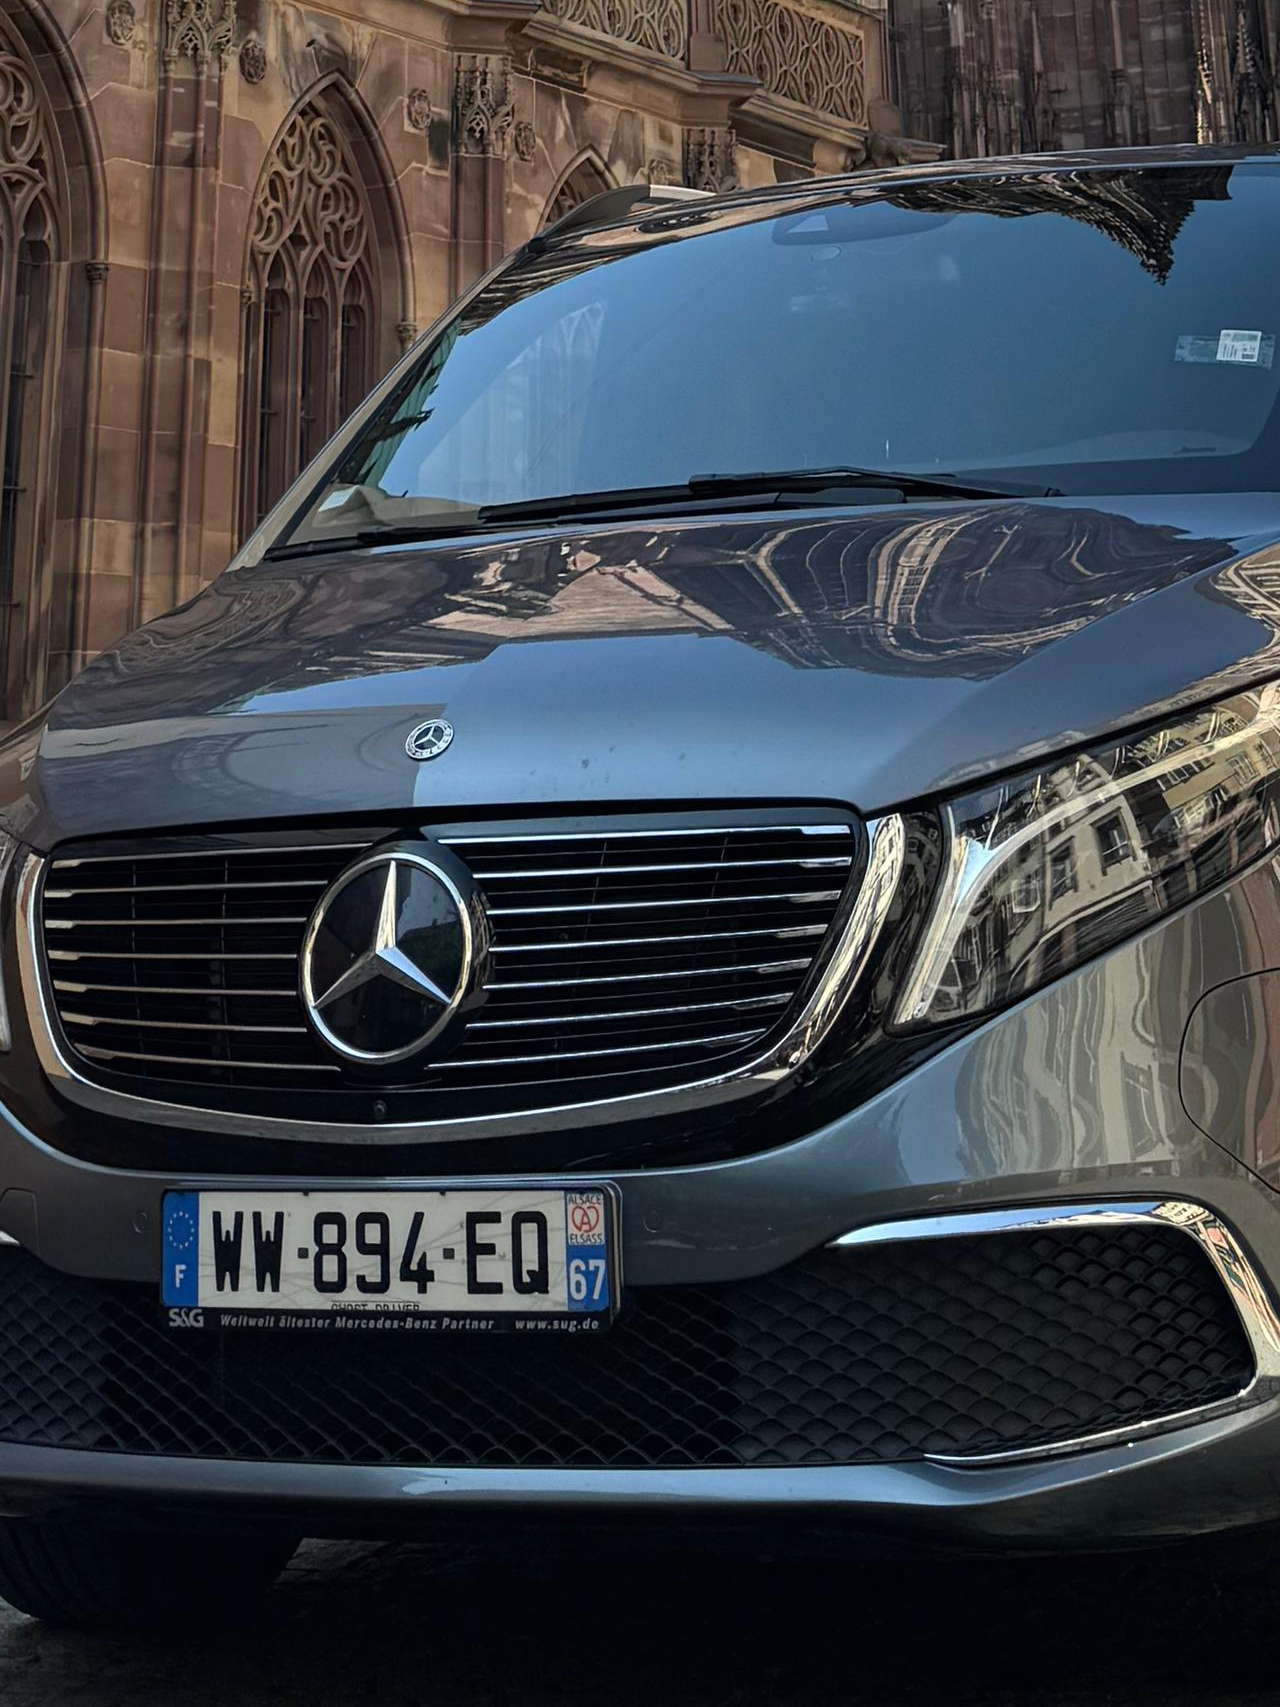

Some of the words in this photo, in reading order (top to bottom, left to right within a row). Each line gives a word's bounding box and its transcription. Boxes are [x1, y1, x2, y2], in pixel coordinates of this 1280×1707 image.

[568, 1194, 602, 1205] ALSACE
[569, 1233, 604, 1244] ELSASS
[175, 1264, 187, 1288] F
[570, 1259, 606, 1301] 67
[168, 1308, 204, 1328] S&G
[220, 1314, 275, 1329] Weltweit
[335, 1316, 437, 1330] Mercedes-Benz
[441, 1317, 495, 1330] Partner
[515, 1318, 599, 1332] www.sug.de
